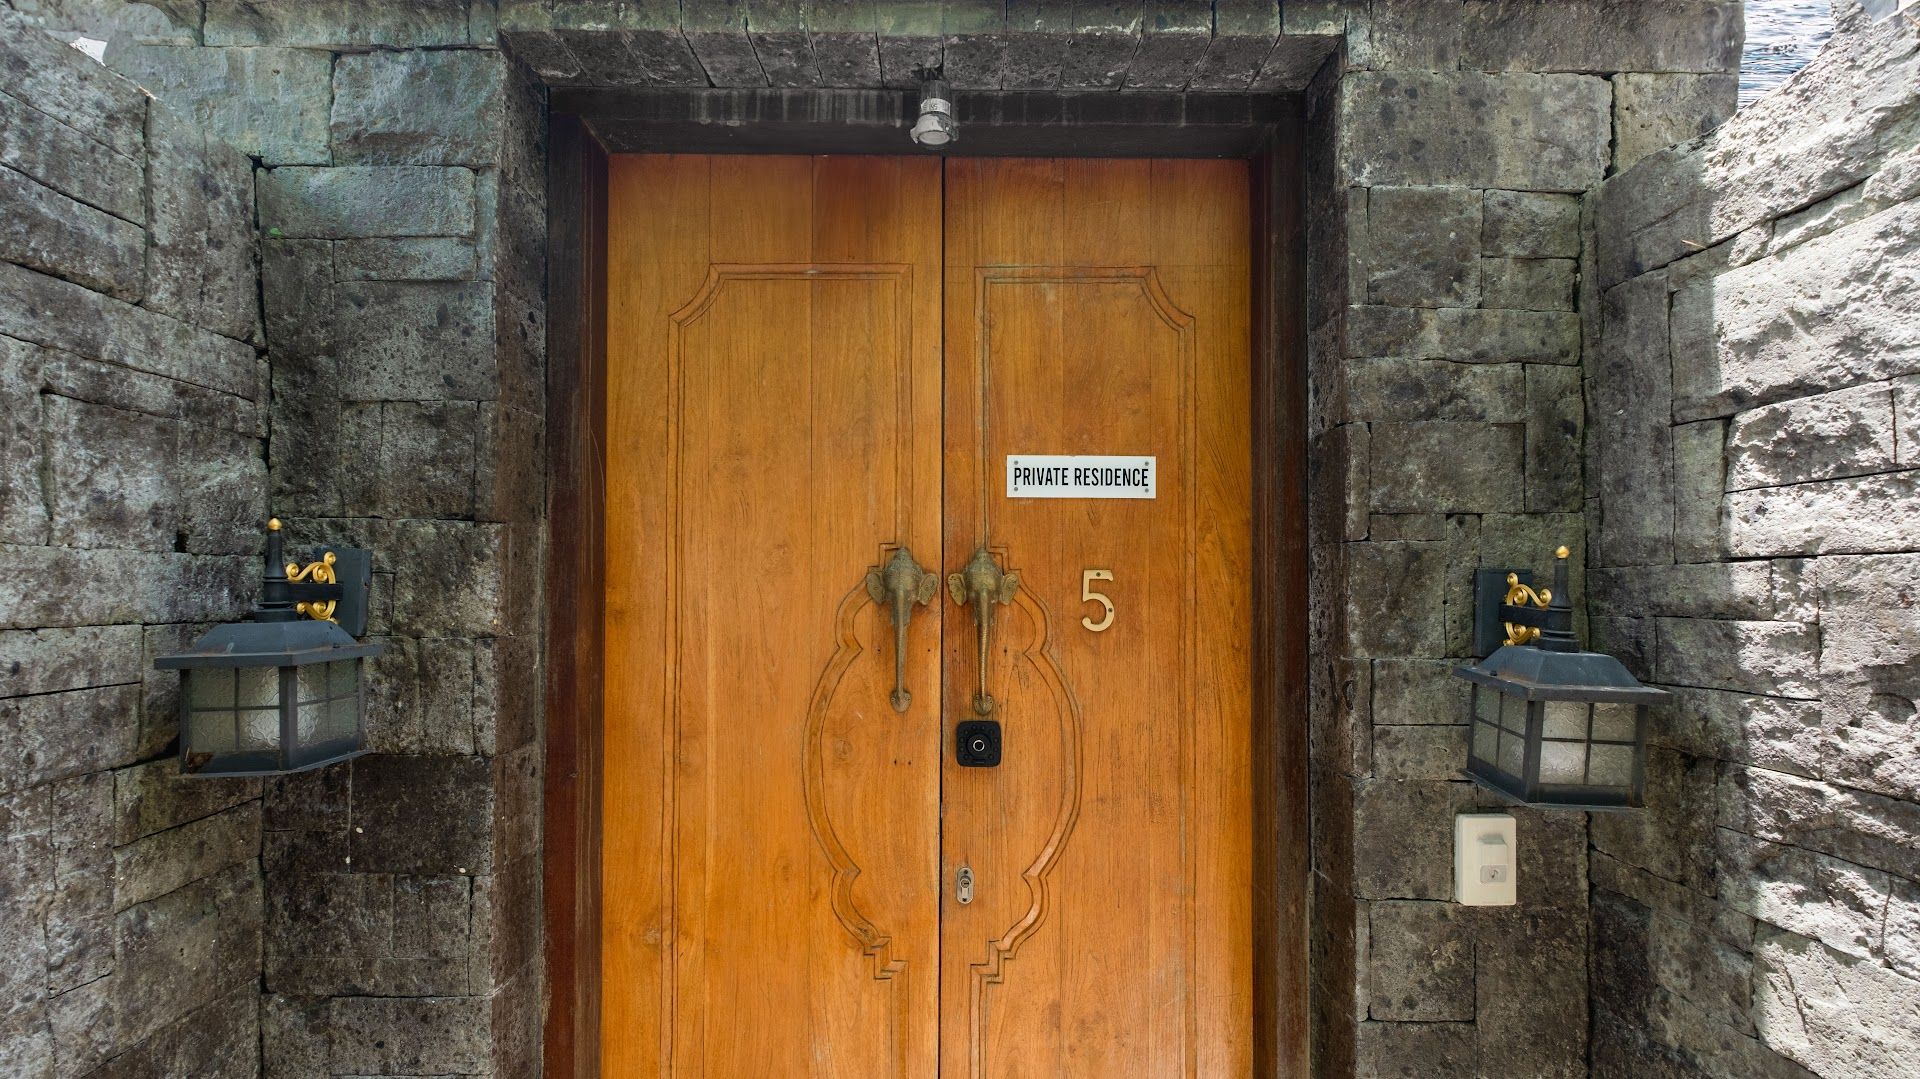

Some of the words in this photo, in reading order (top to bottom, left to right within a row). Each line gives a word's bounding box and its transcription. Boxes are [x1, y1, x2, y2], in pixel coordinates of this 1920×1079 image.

[1014, 467, 1069, 486] PRIVATE
[1074, 467, 1149, 487] RESIDENCE
[1081, 569, 1115, 632] 5
